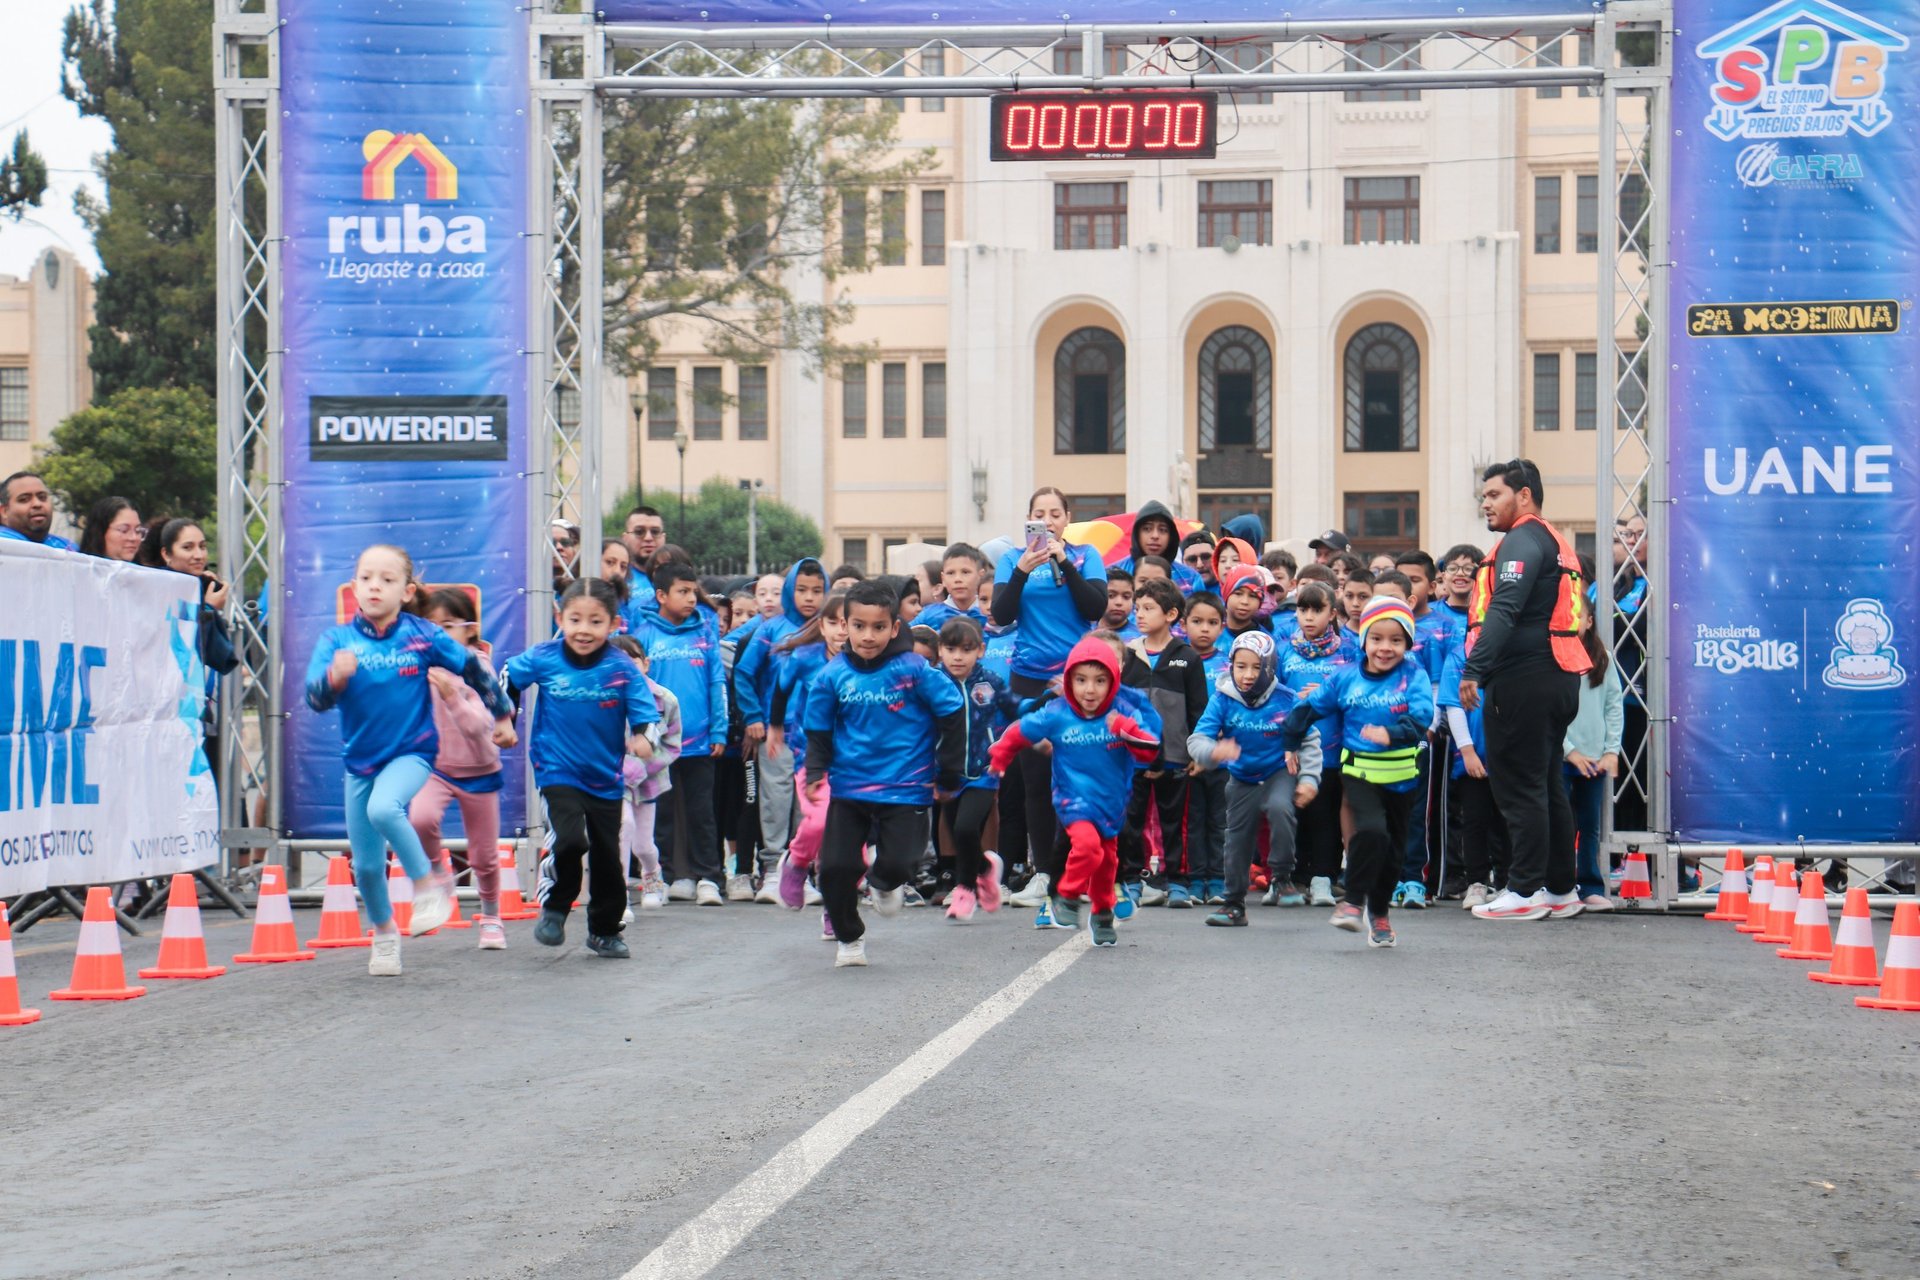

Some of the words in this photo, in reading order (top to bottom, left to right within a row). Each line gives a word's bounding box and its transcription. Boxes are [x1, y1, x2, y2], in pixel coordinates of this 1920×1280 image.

[1715, 29, 1884, 105] SPB
[1765, 90, 1777, 104] EL
[1780, 88, 1825, 104] SÓTANO
[1780, 105, 1791, 115] DE
[1792, 104, 1807, 115] LOS
[1747, 116, 1801, 133] PRECIOS
[1803, 115, 1845, 132] BAJOS
[1768, 153, 1864, 181] GARRA
[328, 203, 487, 254] ruba
[328, 258, 413, 284] Llegaste
[417, 262, 431, 279] a
[438, 261, 485, 279] casa
[1692, 309, 1733, 333] LA
[1743, 305, 1894, 331] MODERNA
[1704, 445, 1893, 496] UANE
[1500, 572, 1523, 581] STAFF
[745, 760, 757, 804] COAHUILA
